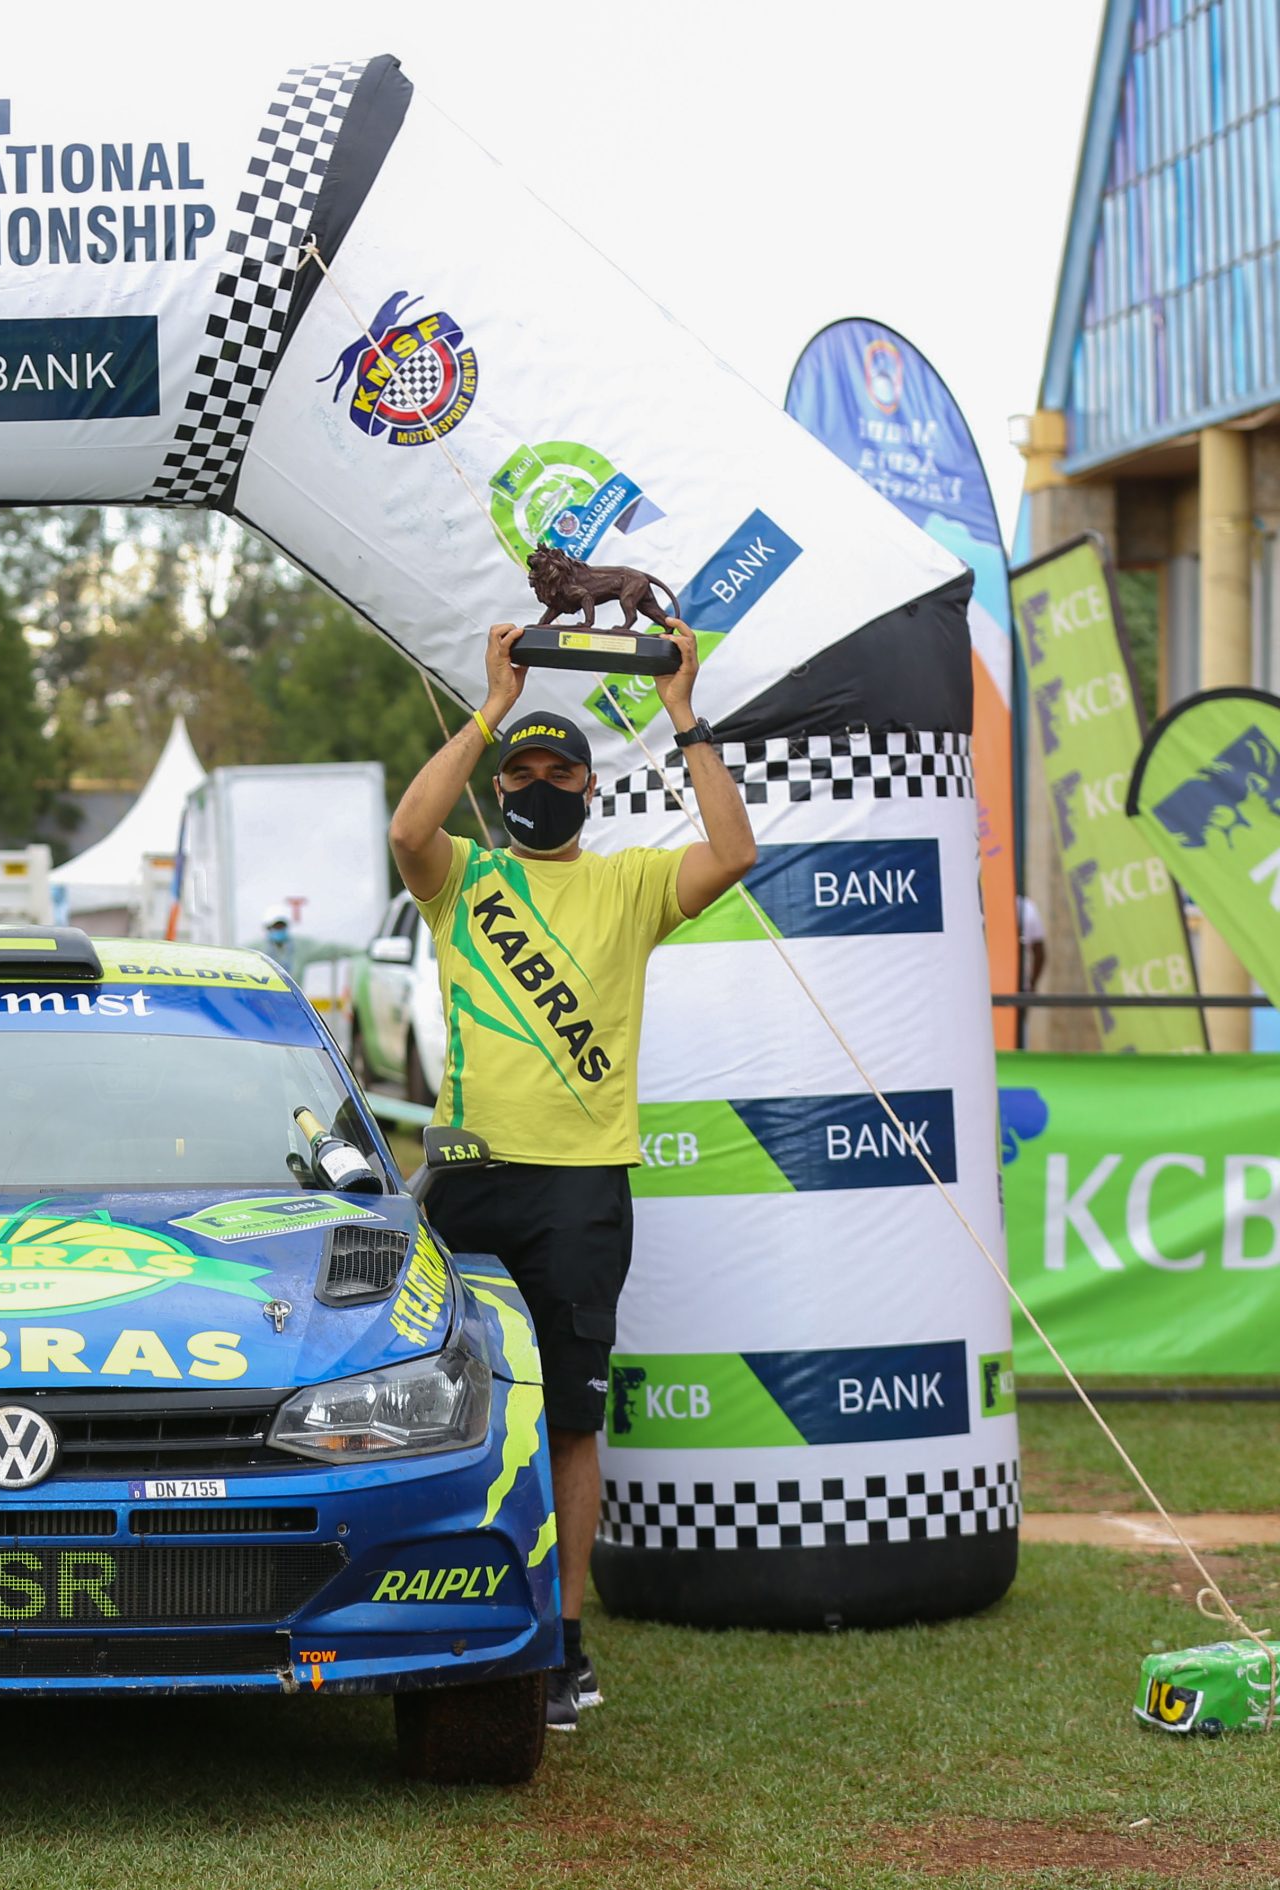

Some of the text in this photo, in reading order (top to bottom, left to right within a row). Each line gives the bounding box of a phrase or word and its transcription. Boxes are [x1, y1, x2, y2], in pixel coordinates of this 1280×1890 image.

[353, 315, 441, 413] KMSF
[396, 351, 475, 445] MOTORSPORT KENYA
[511, 457, 534, 480] KCB
[573, 488, 627, 558] CHAMPIONSHIP
[575, 485, 622, 540] NATIONAL
[710, 536, 777, 605] BANK
[1062, 672, 1128, 725] KCB
[509, 725, 567, 744] KABRAS
[1082, 772, 1126, 819] KC
[813, 868, 920, 907] BANK
[1099, 856, 1170, 908] KCB
[118, 964, 270, 985] BALDEV
[473, 890, 610, 1083] KABRAS
[1120, 954, 1190, 998] KCB
[439, 1143, 481, 1162] T.S.R
[638, 1120, 933, 1168] KCB BANK
[1043, 1152, 1280, 1271] KCB
[646, 1371, 945, 1419] KCB BANK
[155, 1481, 218, 1497] DN Z155
[371, 1564, 510, 1602] RAIPLY
[299, 1650, 337, 1663] TOW
